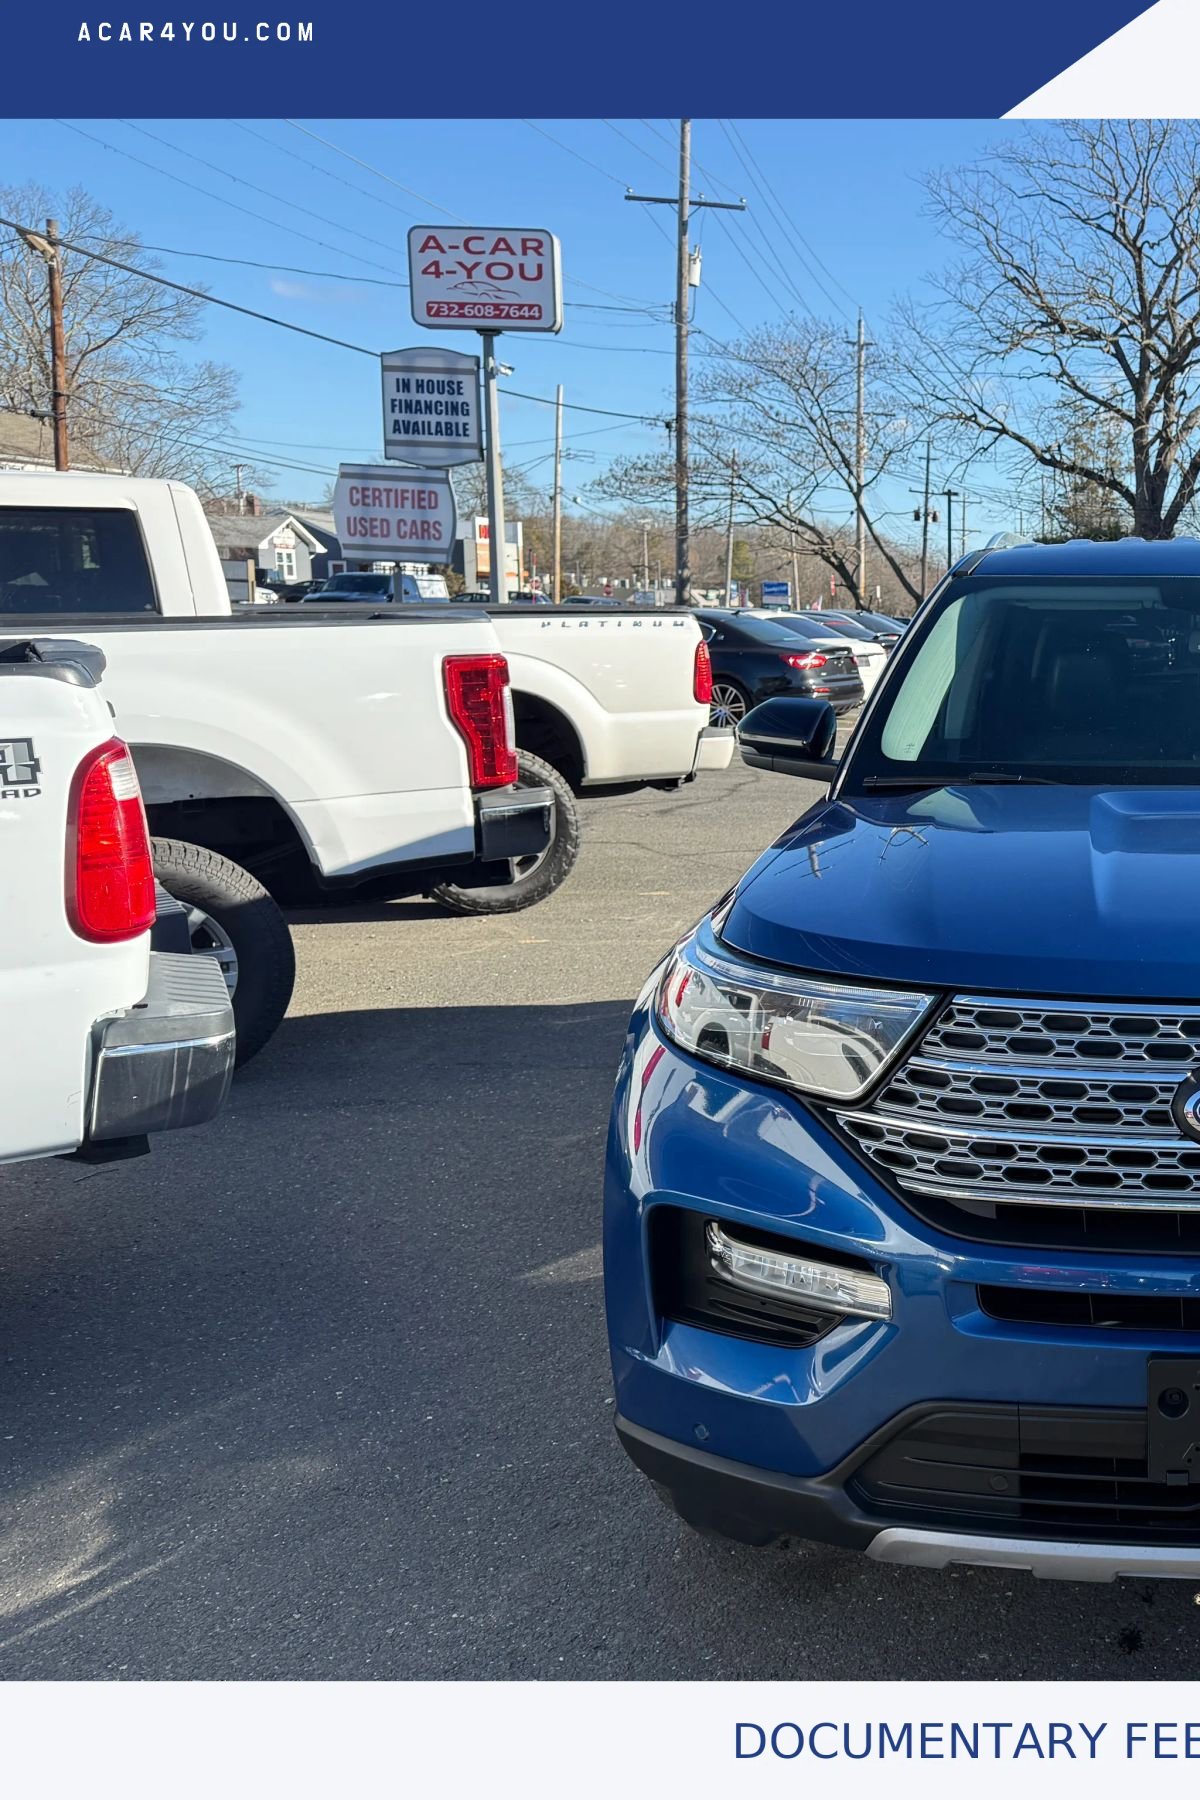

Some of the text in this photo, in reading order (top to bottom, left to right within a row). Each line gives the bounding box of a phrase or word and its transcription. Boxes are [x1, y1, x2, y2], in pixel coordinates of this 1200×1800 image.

[418, 235, 545, 257] A-CAR
[421, 259, 543, 282] 4-YOU
[428, 303, 540, 318] 732-608-7644
[396, 377, 464, 396] IN HOUSE
[390, 398, 470, 417] FINANCING
[392, 419, 470, 437] AVAILABLE
[349, 486, 439, 510] CERTIFIED
[346, 516, 443, 541] USED CARS
